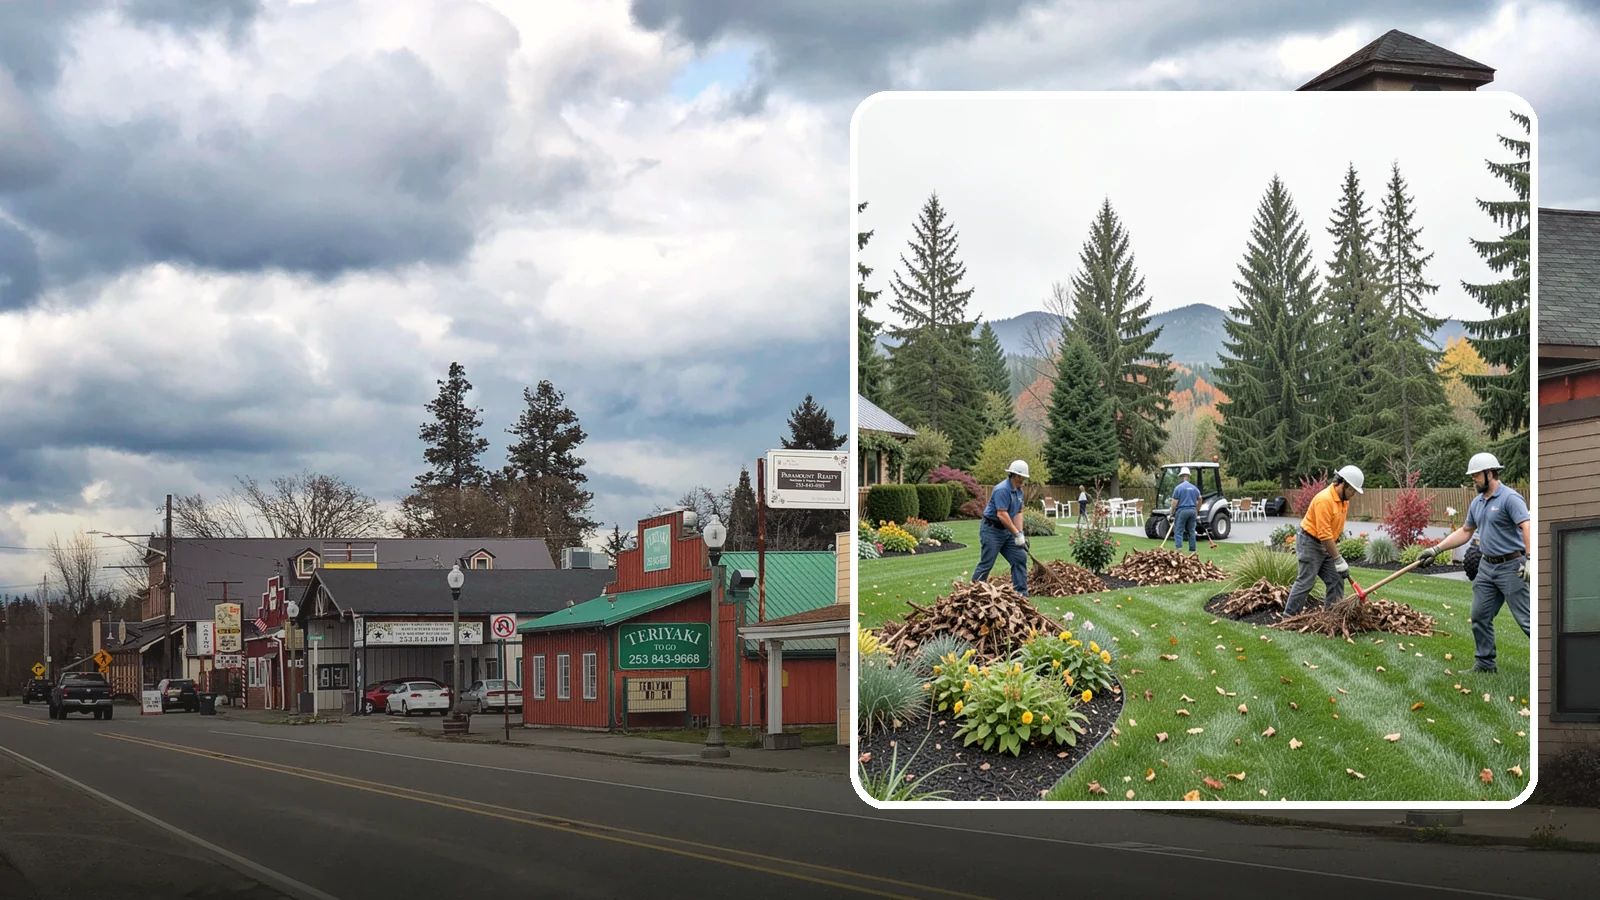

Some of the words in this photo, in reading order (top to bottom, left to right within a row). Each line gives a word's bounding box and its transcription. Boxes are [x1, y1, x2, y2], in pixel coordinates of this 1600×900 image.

[781, 471, 815, 479] PARAMOUNT
[817, 472, 839, 480] REALTY
[646, 531, 669, 549] TERIYAKI
[624, 627, 702, 646] TERIYAKI
[665, 643, 677, 651] GO
[628, 654, 649, 665] 253
[651, 653, 700, 664] 843-9668
[639, 681, 672, 691] TERIYAKI
